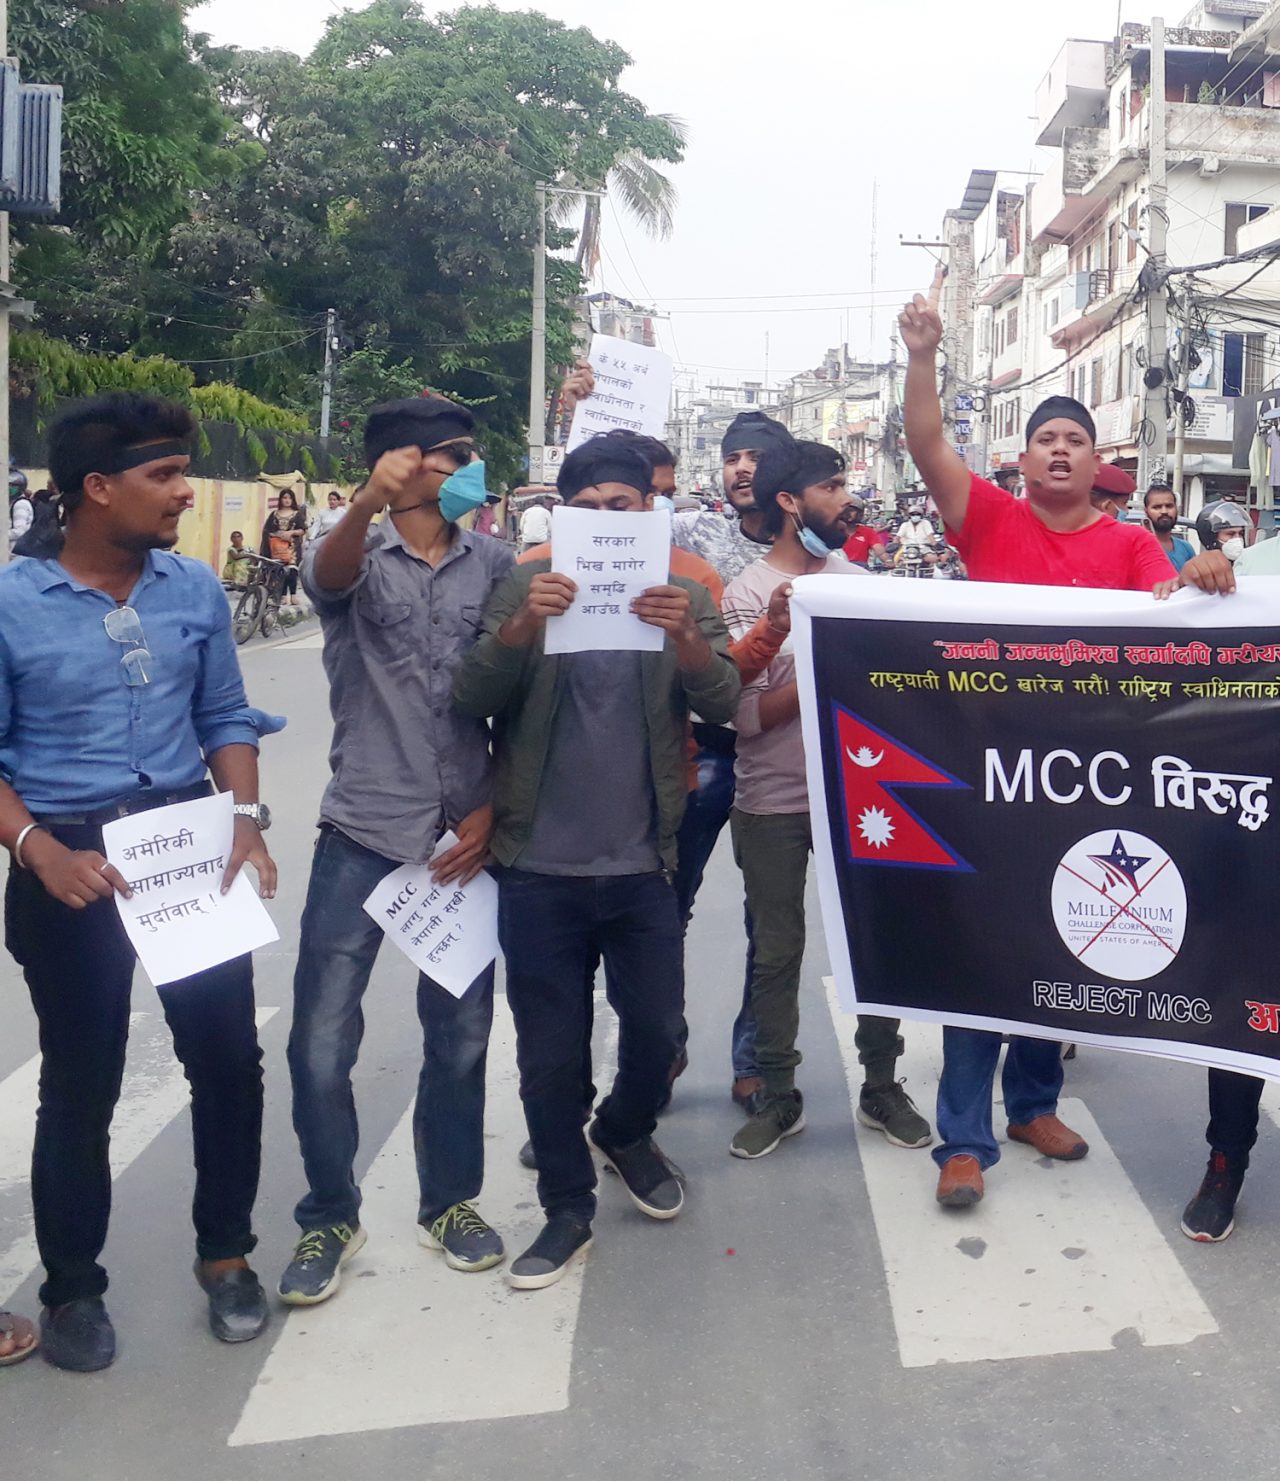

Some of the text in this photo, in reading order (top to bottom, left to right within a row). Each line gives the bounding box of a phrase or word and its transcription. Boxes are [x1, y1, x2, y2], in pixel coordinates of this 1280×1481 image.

[593, 370, 633, 390] नेपालको
[584, 408, 644, 431] स्वाभिमानको
[592, 535, 637, 547] सरकार
[576, 556, 646, 572] भिख मागेर
[590, 580, 627, 596] समृद्धि
[1124, 641, 1212, 665] स्वर्गादपि
[868, 670, 940, 693] राष्ट्रघाती
[947, 671, 1008, 693] MCC
[1016, 674, 1064, 694] खारेज
[1118, 676, 1172, 702] राष्ट्रिय
[984, 748, 1133, 805] MCC
[122, 828, 194, 862] अमेरिकी
[129, 856, 224, 895] साम्राज्यवाद
[385, 881, 418, 920] MCC
[400, 910, 424, 934] लागु
[411, 890, 467, 946] नेपाली सुखी
[1068, 919, 1173, 935] CHALLENGE CORPORATION
[1101, 936, 1127, 945] STATES
[1130, 938, 1140, 946] OF
[1033, 980, 1212, 1024] REJECT MCC
